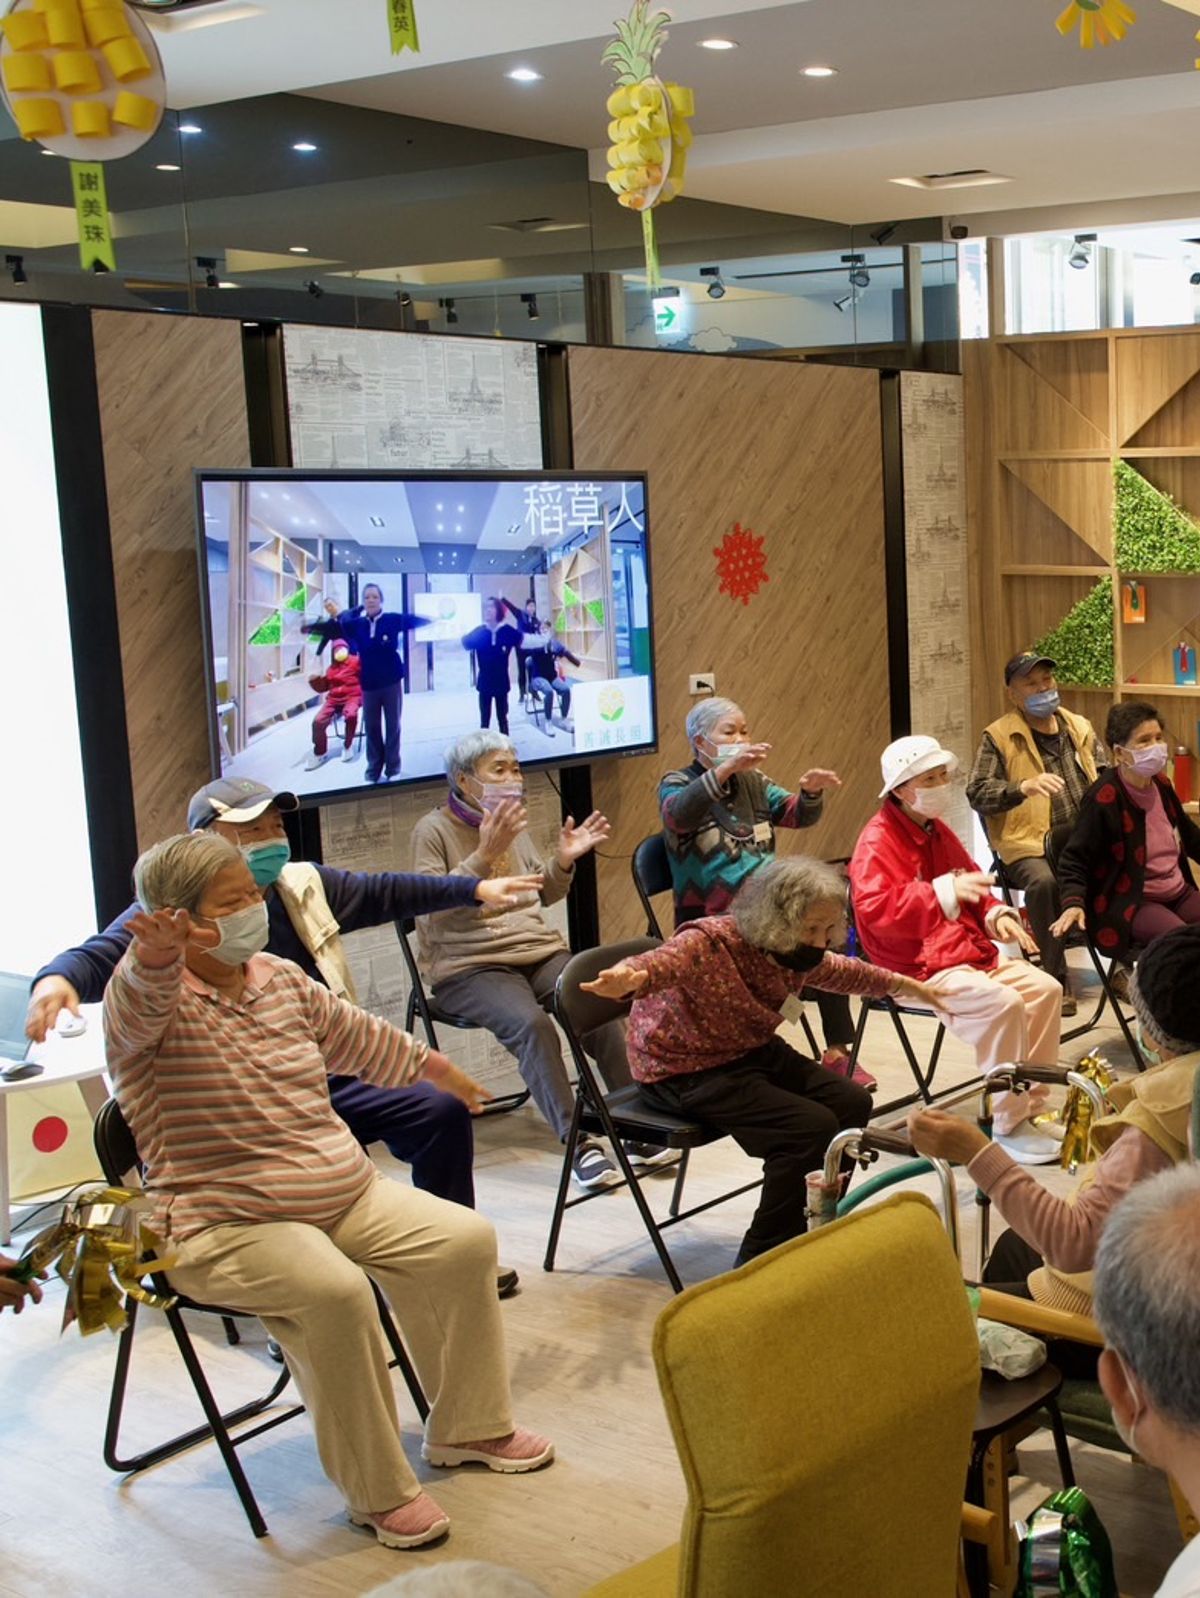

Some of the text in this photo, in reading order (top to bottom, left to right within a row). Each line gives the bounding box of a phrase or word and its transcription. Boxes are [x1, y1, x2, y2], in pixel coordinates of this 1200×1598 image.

[79, 172, 105, 243] 謝美珠
[524, 483, 644, 535] 稻草人
